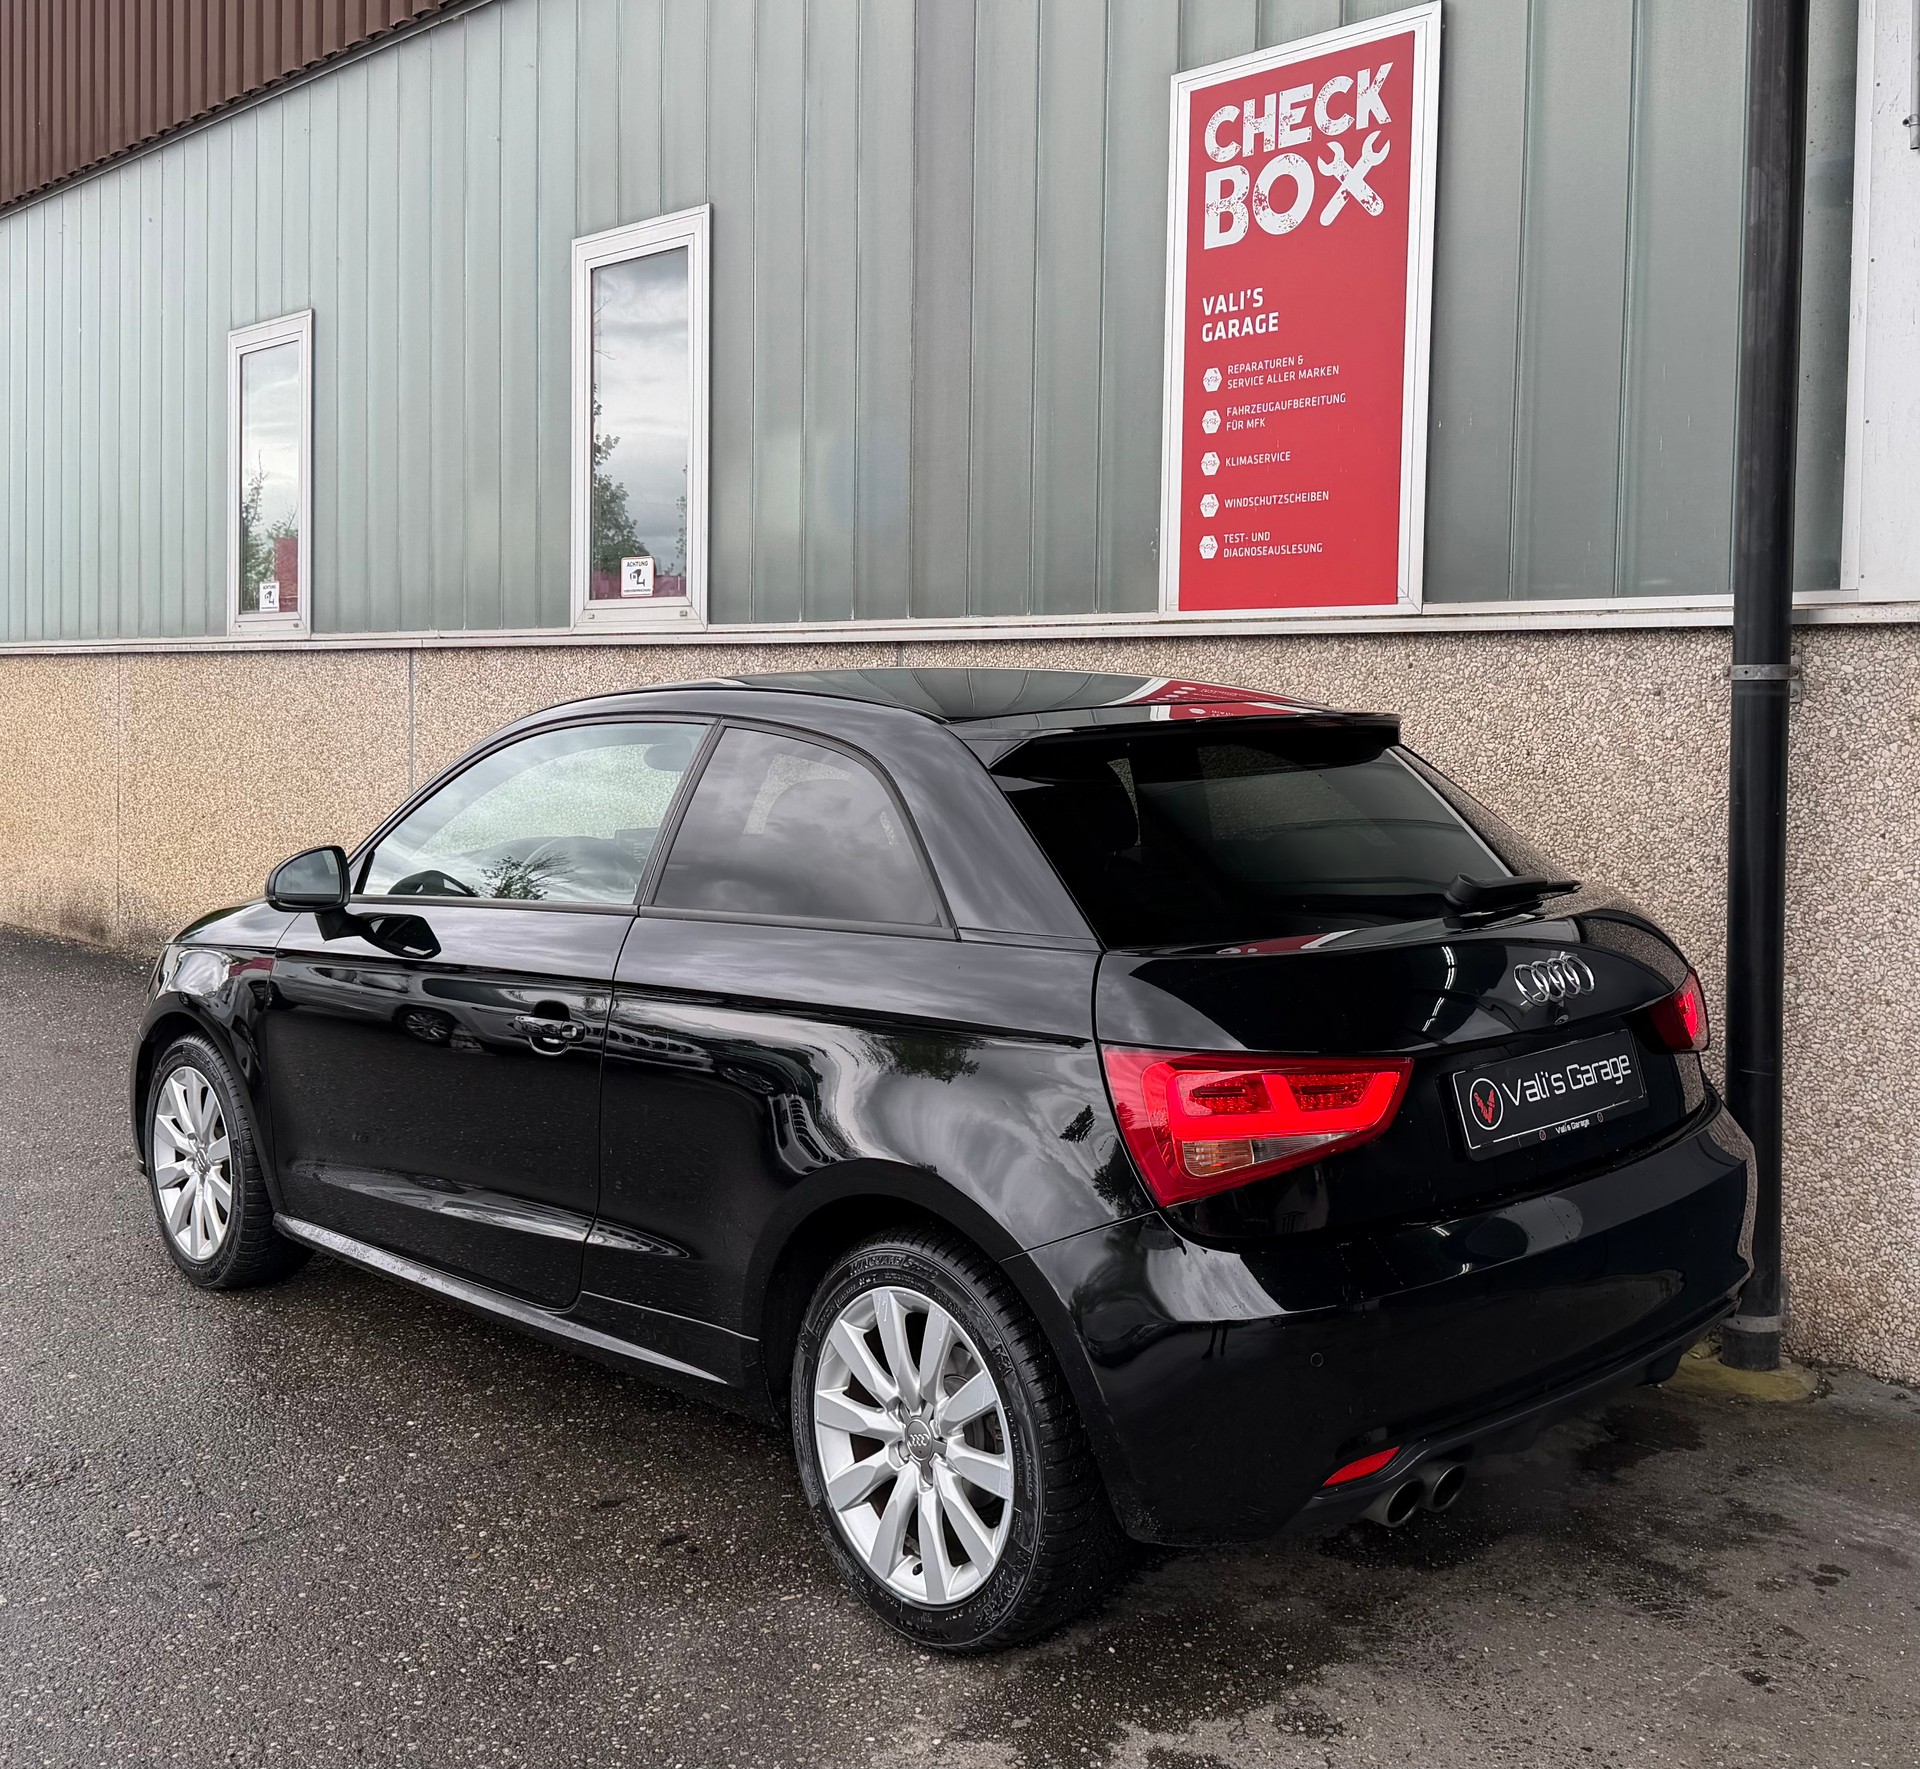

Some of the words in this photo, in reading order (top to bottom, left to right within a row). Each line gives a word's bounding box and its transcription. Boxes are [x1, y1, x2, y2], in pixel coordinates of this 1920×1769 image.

[1204, 61, 1394, 163] CHECK
[1203, 130, 1391, 250] BOX
[1202, 287, 1264, 316] VALI'S
[1201, 311, 1280, 343] GARAGE
[1227, 356, 1295, 375] REPARATUREN
[1297, 354, 1304, 365] &
[1227, 375, 1264, 390] SERVICE
[1266, 372, 1296, 385] ALLER
[1298, 365, 1340, 380] MARKEN
[1226, 392, 1346, 417] FAHRZEUGAUFBEREITUNG
[1226, 418, 1244, 432] FÜR
[1246, 417, 1266, 430] MFK
[1225, 451, 1291, 467] KLIMASERVICE
[1224, 491, 1329, 508] WINDSCHUTZSCHEIBEN
[1223, 533, 1249, 544] TEST-
[1251, 531, 1271, 542] UND
[1223, 542, 1323, 558] DIAGNOSEAUSLESUNG
[1501, 1070, 1566, 1106] Vali's
[1567, 1054, 1632, 1091] Garage
[1571, 1118, 1590, 1130] Garage
